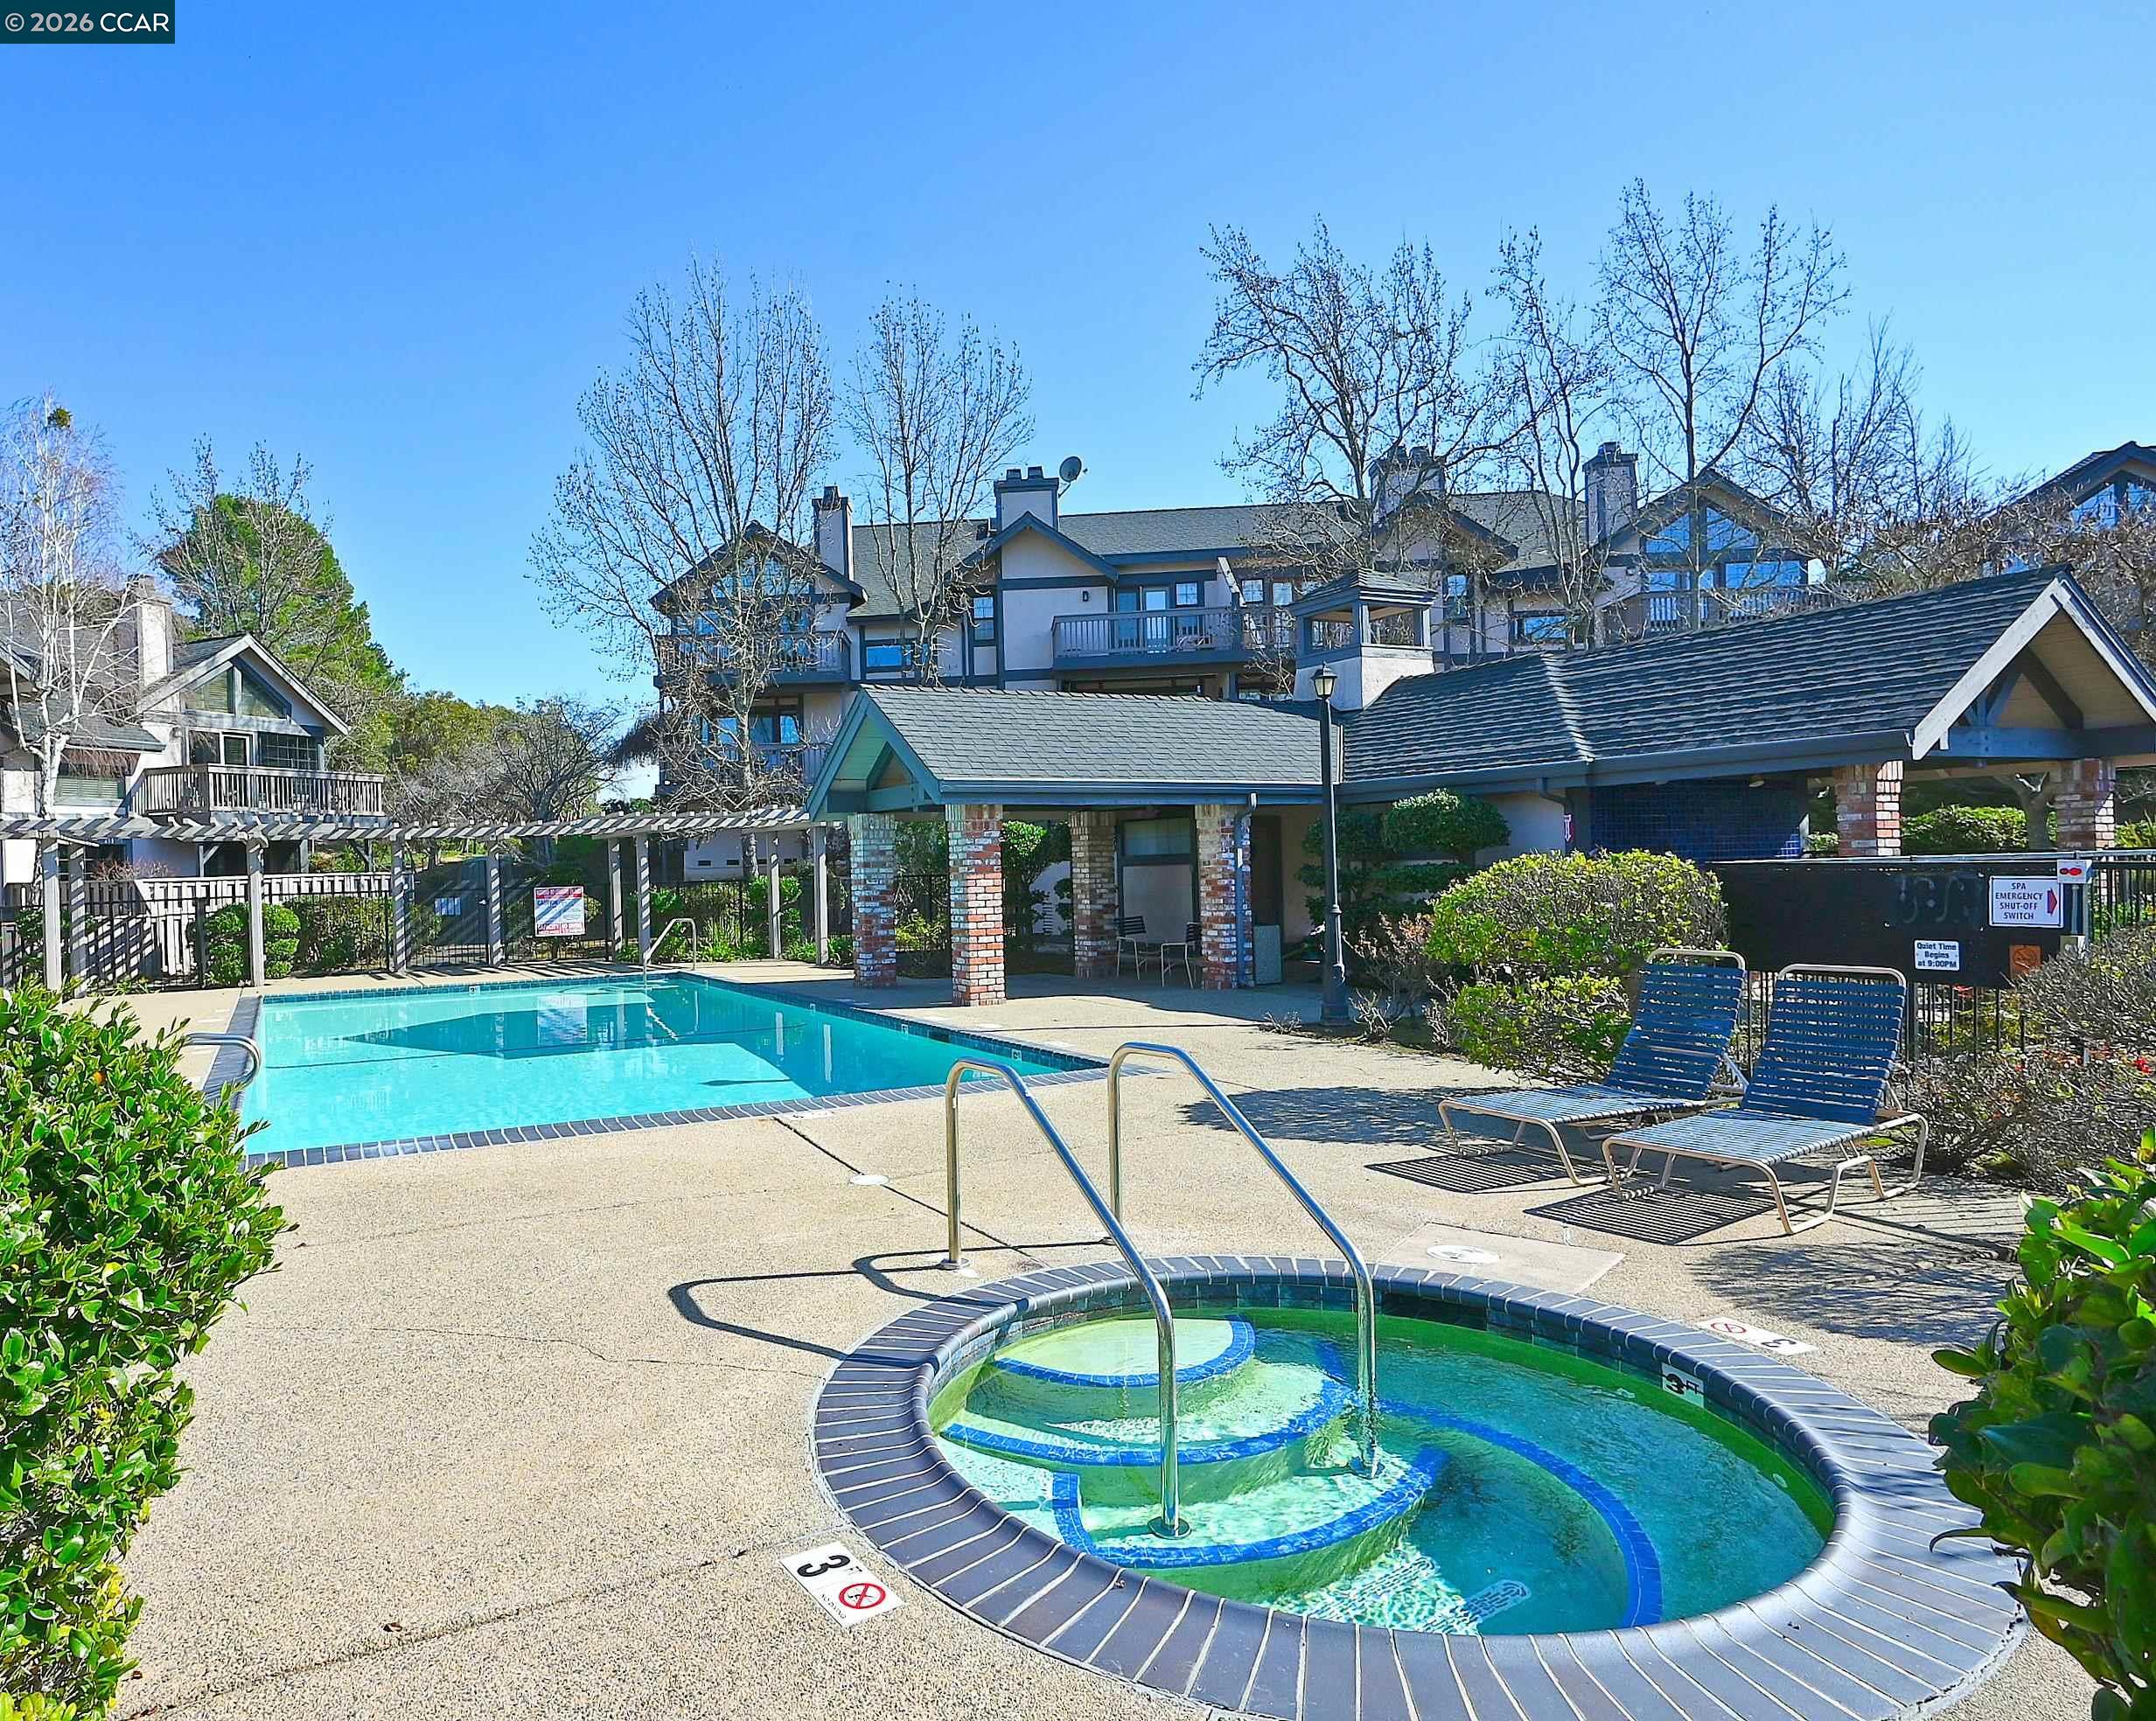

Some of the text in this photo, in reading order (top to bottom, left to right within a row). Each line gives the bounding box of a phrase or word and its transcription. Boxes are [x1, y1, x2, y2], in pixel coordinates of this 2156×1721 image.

[1761, 1339, 1797, 1348] 3
[1666, 1373, 1699, 1394] 3 FT
[797, 1554, 851, 1578] 3
